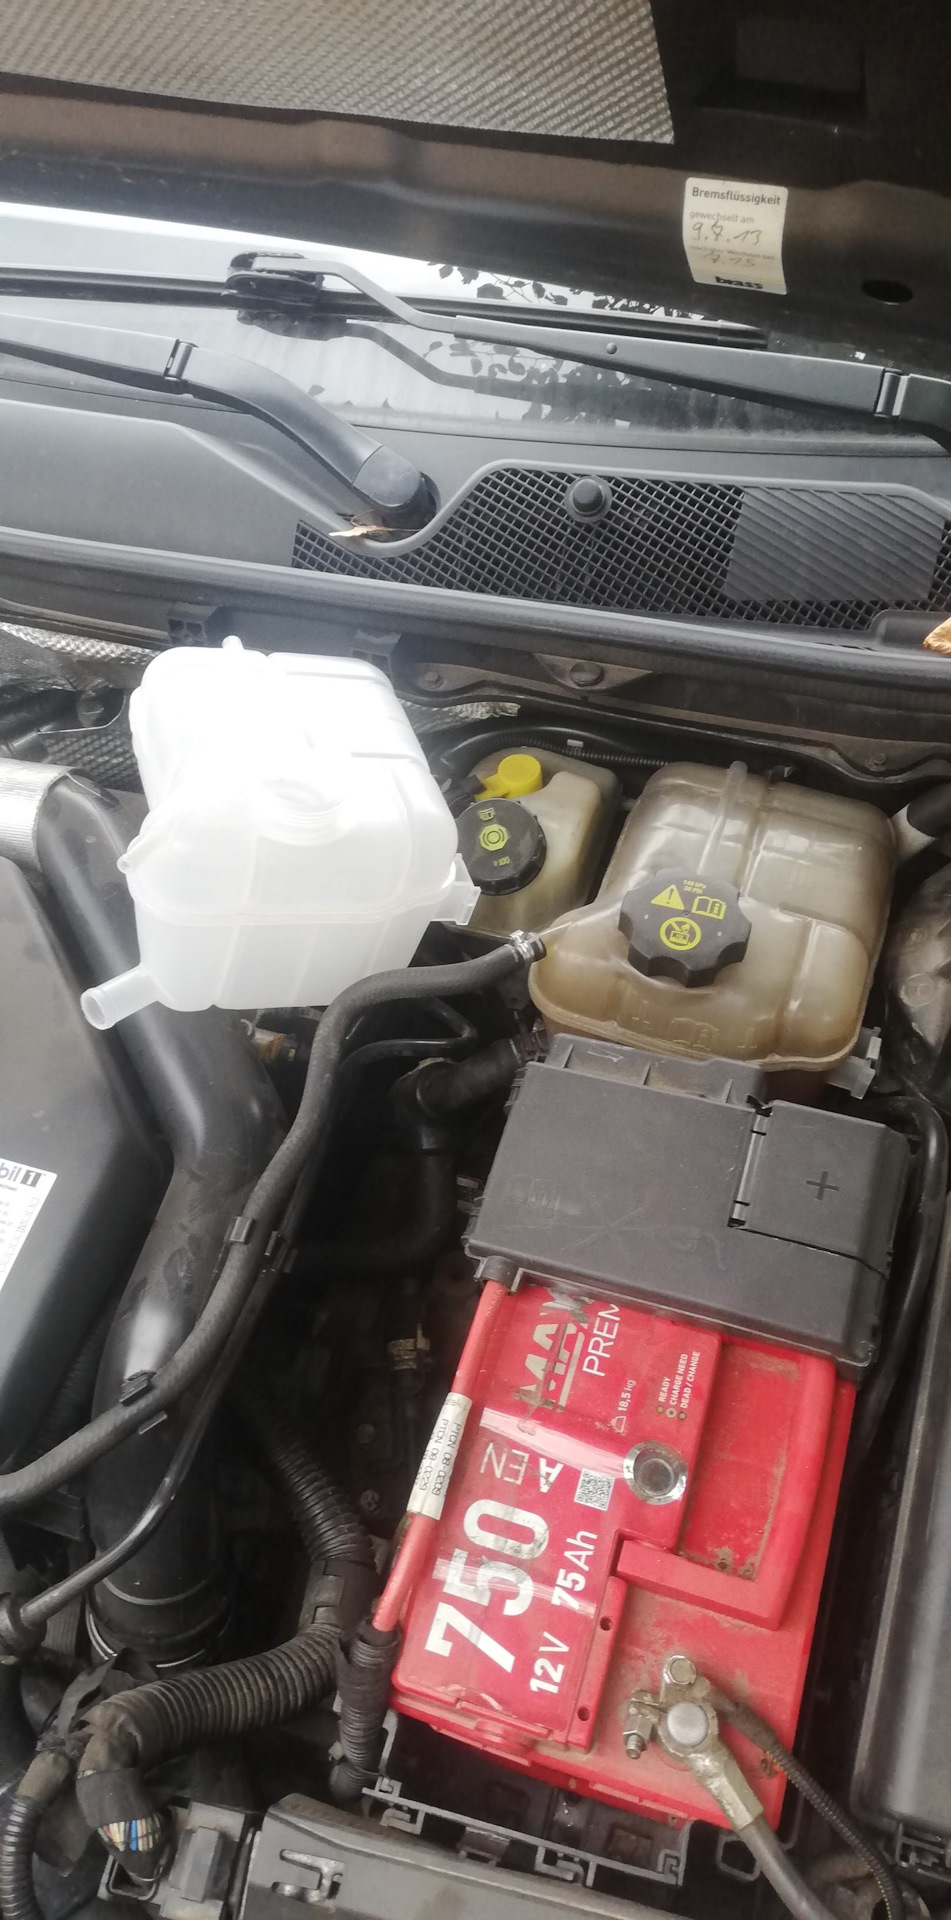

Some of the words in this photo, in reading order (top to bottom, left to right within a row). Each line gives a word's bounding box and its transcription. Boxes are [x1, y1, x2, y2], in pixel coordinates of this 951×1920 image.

[692, 187, 781, 205] Bremsflüssigkeit
[689, 211, 738, 222] gewechselt
[740, 216, 755, 224] am
[617, 1392, 631, 1412] 18,5
[624, 1379, 637, 1391] kg
[658, 1376, 671, 1402] READY
[669, 1375, 683, 1405] CHARGE
[677, 1353, 688, 1374] NEED
[680, 1387, 691, 1409] DEAD
[686, 1351, 701, 1382] CHANGE
[479, 1441, 529, 1485] EN
[538, 1458, 564, 1493] A
[563, 1530, 598, 1572] Ah
[424, 1499, 549, 1673] 750
[550, 1568, 586, 1610] 75
[538, 1631, 570, 1653] V
[529, 1657, 565, 1694] 12
